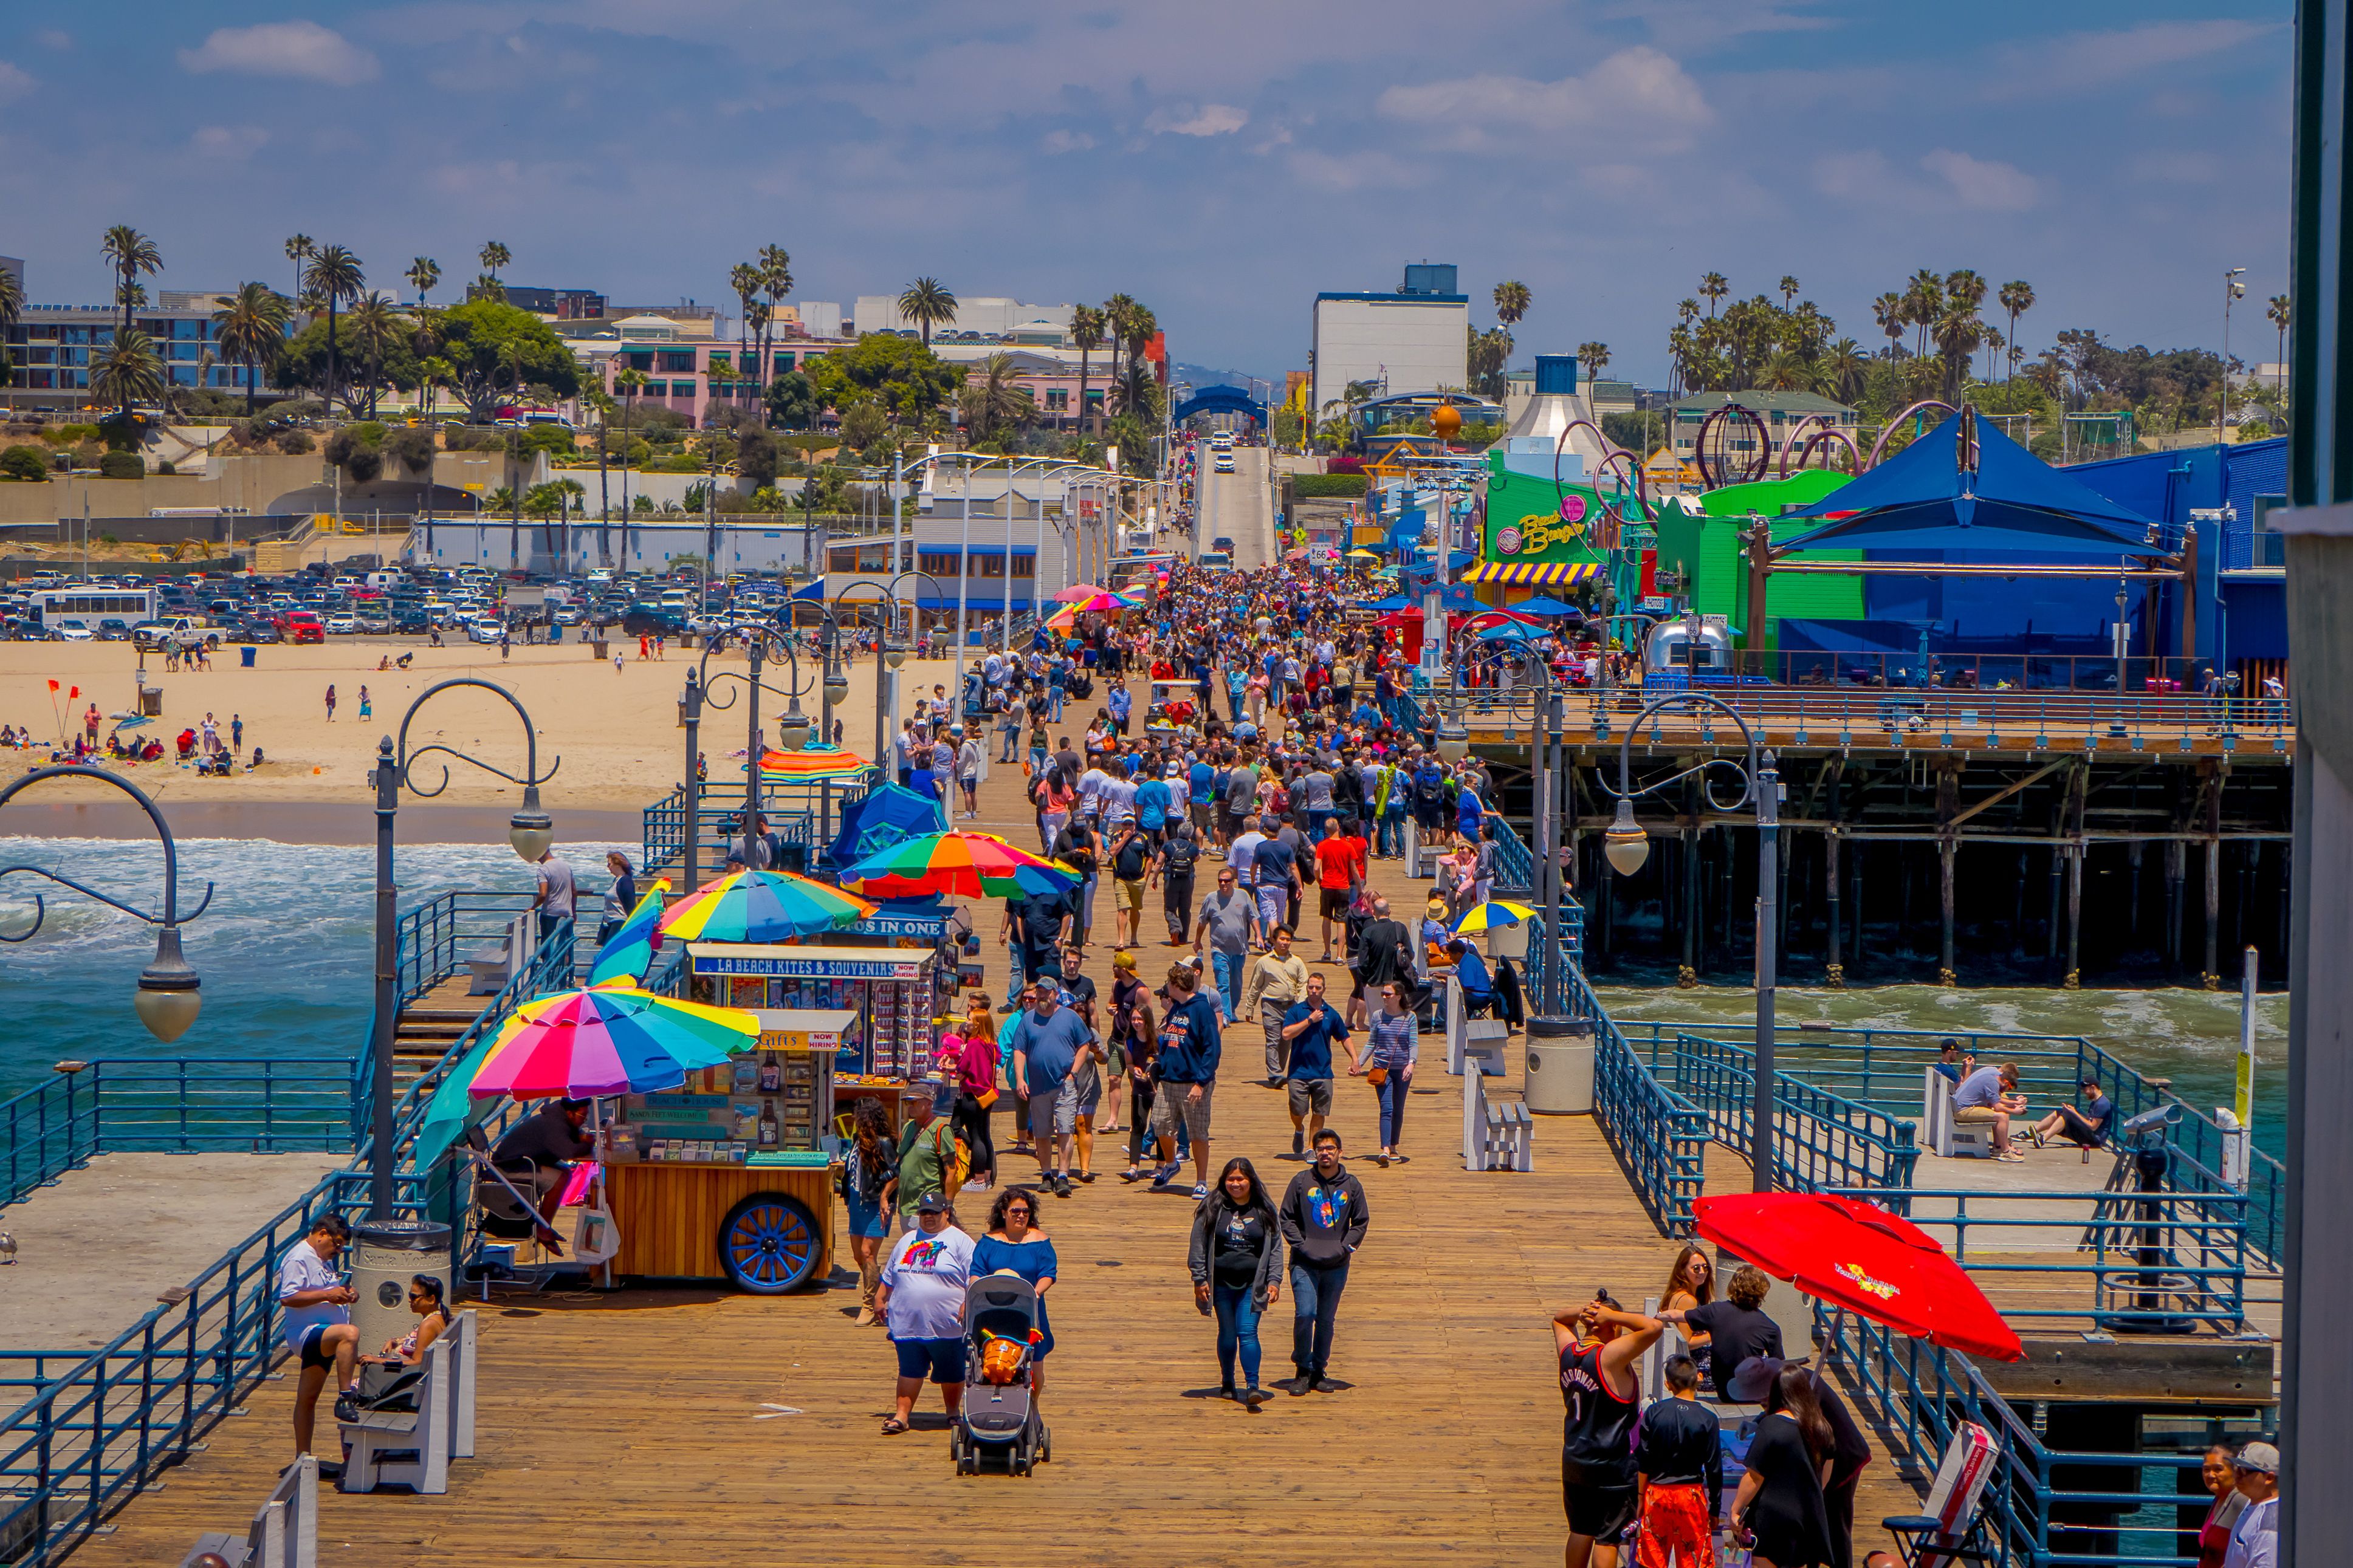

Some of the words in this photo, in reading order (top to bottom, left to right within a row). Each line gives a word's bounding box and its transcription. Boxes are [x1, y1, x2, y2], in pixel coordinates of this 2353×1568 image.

[1522, 522, 1585, 554] Burger
[1316, 550, 1326, 559] 66
[1646, 597, 1663, 608] PHOTOS
[881, 921, 899, 934] IN
[904, 922, 940, 935] ONE
[718, 959, 732, 972] LA
[735, 959, 773, 973] BEACH
[777, 960, 812, 974] KITES
[816, 961, 824, 974] &
[829, 961, 895, 976] SOUVENIRS
[648, 1096, 681, 1106] BEACH
[630, 1110, 650, 1119] SANDY
[365, 1250, 397, 1267] Santa
[1573, 1391, 1580, 1421] 1
